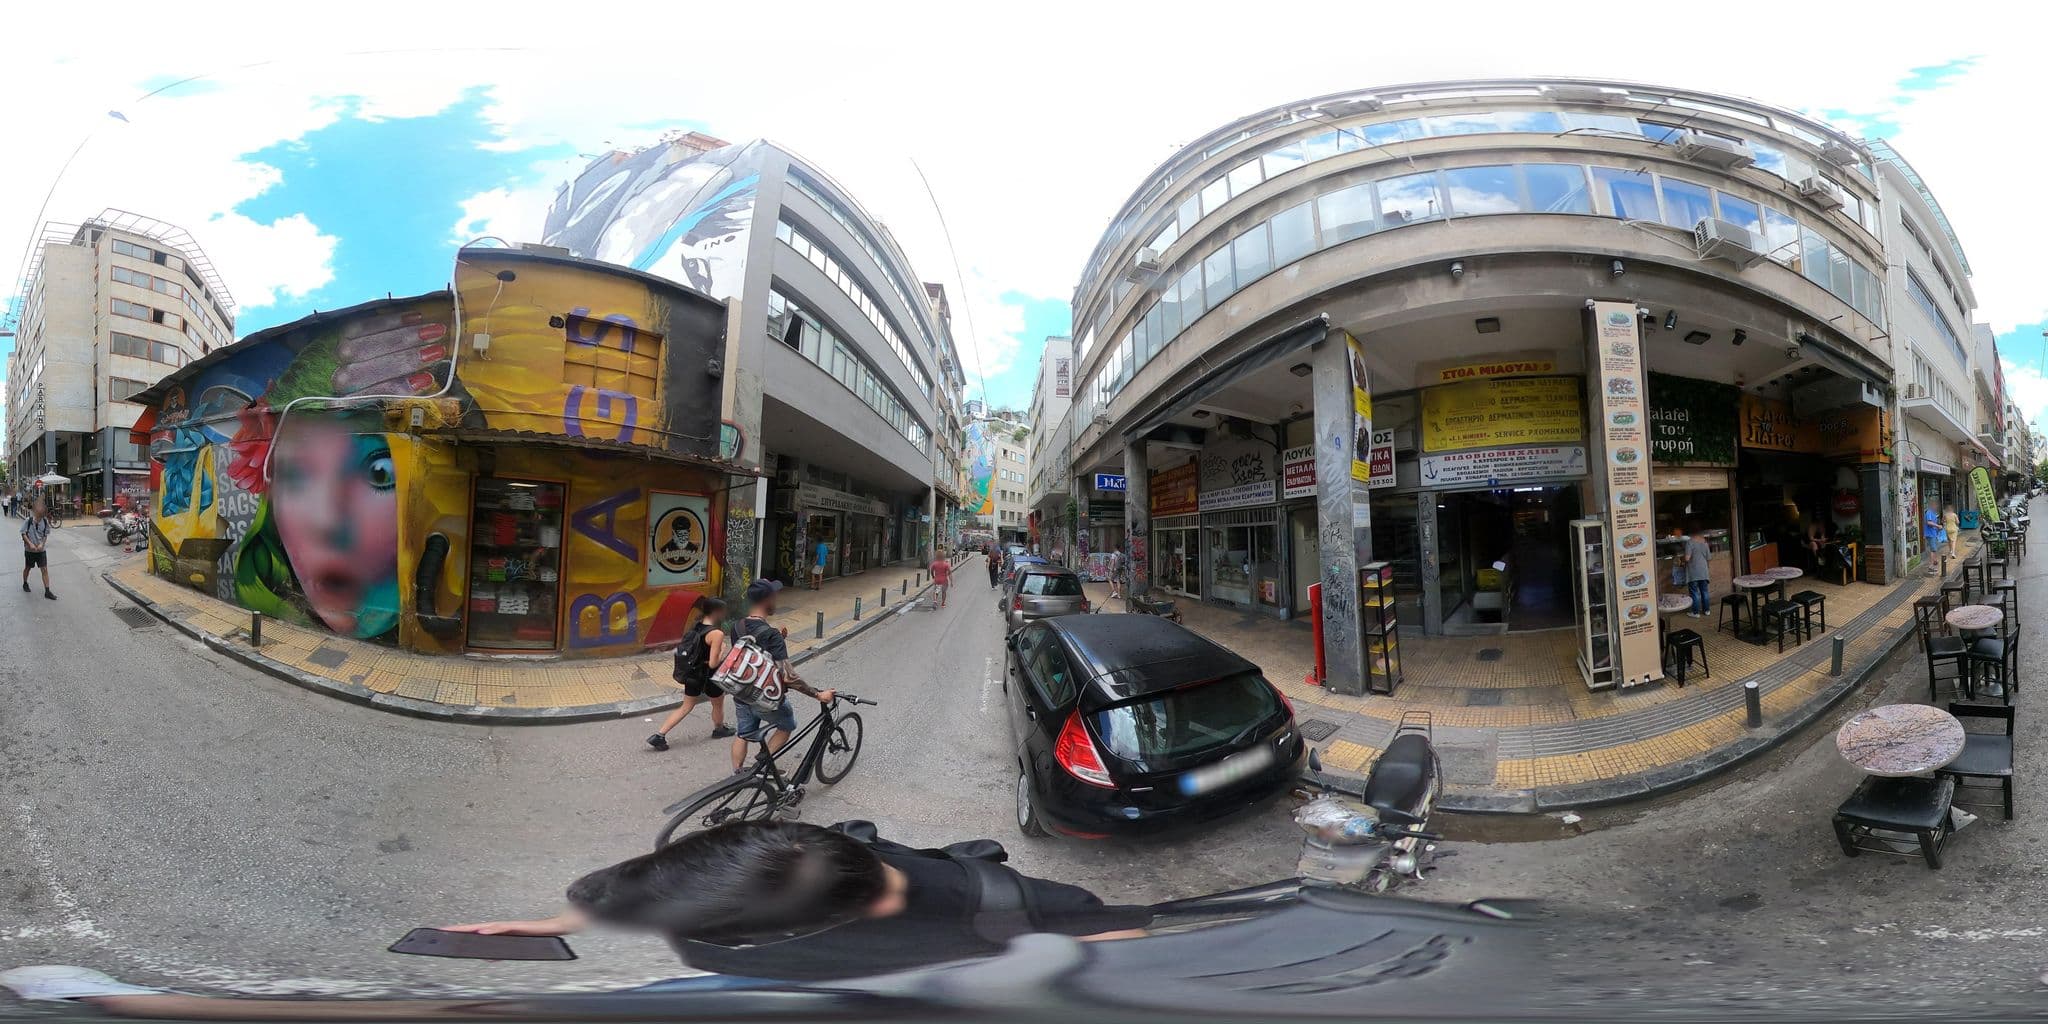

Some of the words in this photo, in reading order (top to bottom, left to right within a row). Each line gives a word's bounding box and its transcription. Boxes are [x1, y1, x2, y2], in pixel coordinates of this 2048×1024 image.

[705, 236, 736, 250] INO
[1443, 368, 1475, 380] ΣΤΟΑ
[1494, 429, 1525, 438] SERVICE
[1372, 464, 1391, 474] ΕΙΔΩΝ
[218, 493, 259, 517] BAGS
